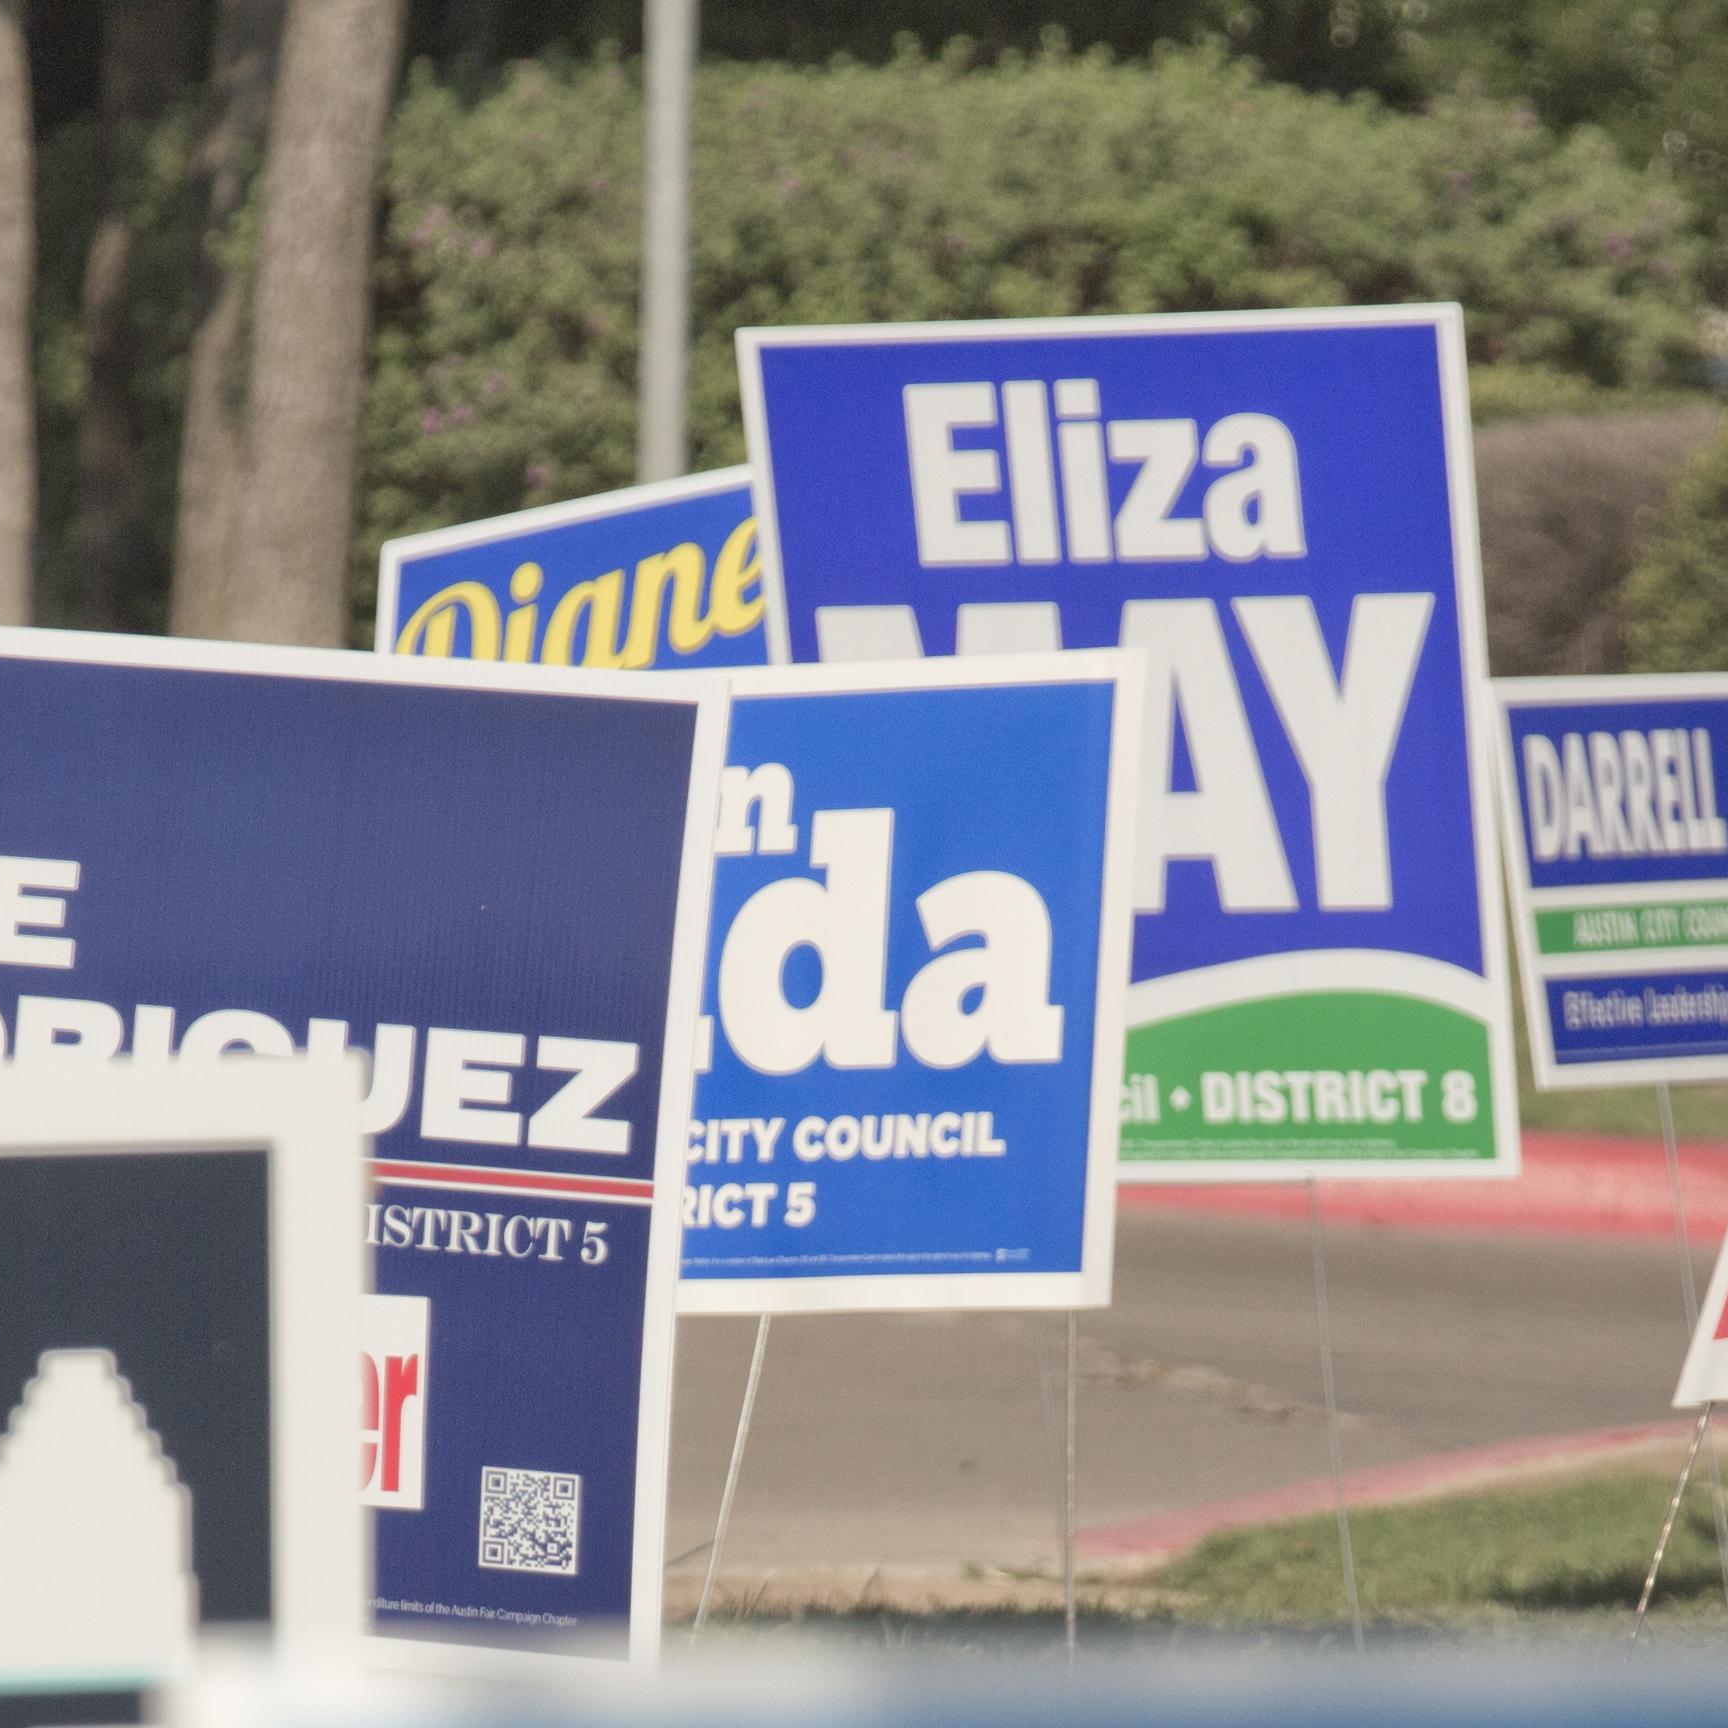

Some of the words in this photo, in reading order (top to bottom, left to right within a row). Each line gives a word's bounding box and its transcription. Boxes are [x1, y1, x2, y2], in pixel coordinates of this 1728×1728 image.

[902, 377, 1310, 569] Eliza
[815, 591, 1438, 914] AY
[1523, 727, 1728, 864] DARRELL
[1199, 1068, 1428, 1125] DISTRICT
[1440, 1070, 1479, 1124] 8
[792, 1111, 1007, 1162] COUNCIL
[784, 1181, 818, 1229] 5
[579, 1219, 610, 1266] 5
[400, 1598, 423, 1613] limits
[424, 1601, 435, 1614] of
[435, 1601, 451, 1616] the
[451, 1604, 479, 1618] Austin
[480, 1606, 496, 1620] Fair
[496, 1607, 542, 1625] Campaign
[542, 1613, 578, 1628] Chapter
